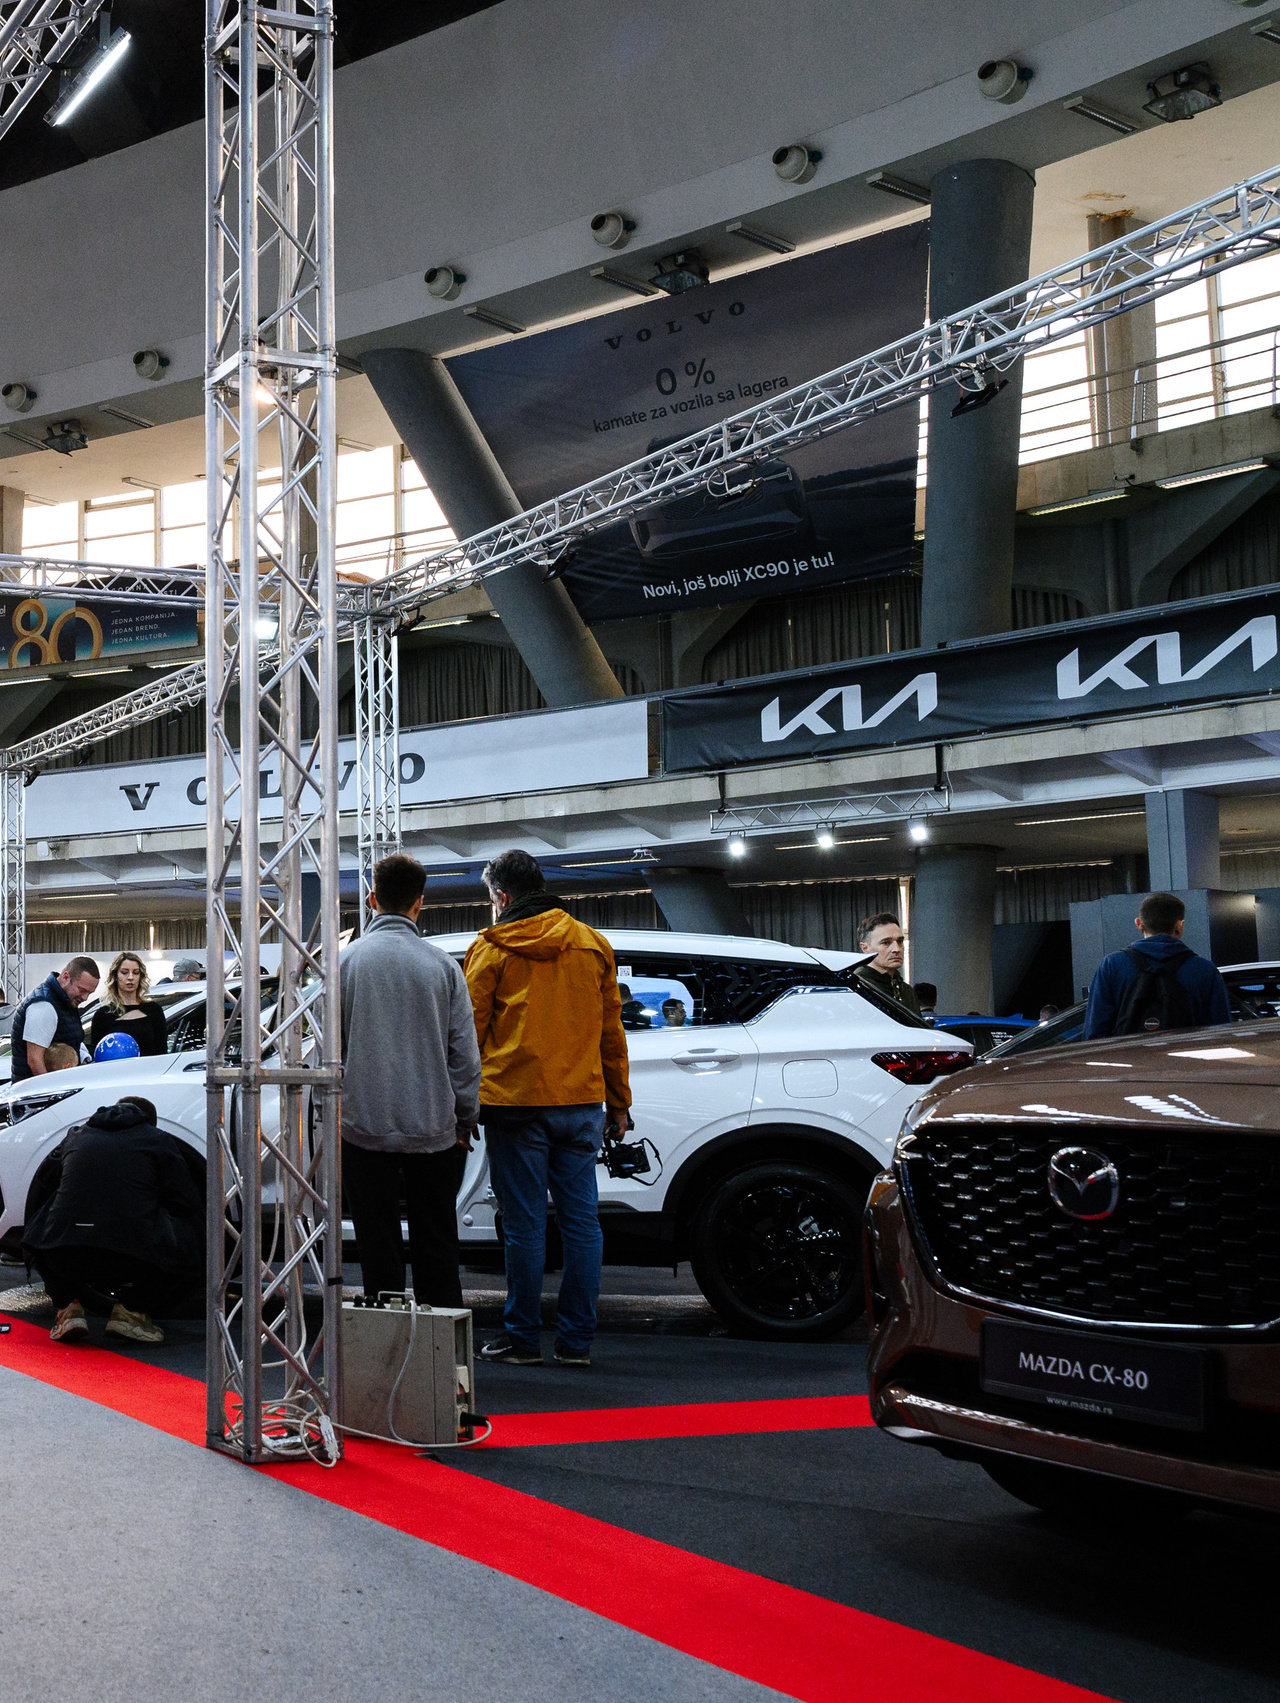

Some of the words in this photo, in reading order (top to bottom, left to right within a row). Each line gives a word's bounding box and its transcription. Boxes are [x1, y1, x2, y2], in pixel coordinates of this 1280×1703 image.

[604, 301, 746, 350] VOLVO
[594, 411, 647, 433] kamate
[650, 405, 668, 421] za
[670, 393, 713, 415] vozila
[717, 388, 735, 405] sa
[737, 374, 789, 402] lagera
[642, 579, 681, 600] Novi,
[683, 571, 707, 593] još
[709, 566, 742, 590] bolji
[744, 560, 789, 583] XC90
[793, 560, 808, 580] je
[811, 552, 836, 572] tu!
[111, 617, 133, 626] JEDNA
[135, 612, 178, 622] KOMPANIJA.
[111, 627, 133, 635] JEDAN
[135, 624, 160, 632] BREND.
[111, 637, 133, 645] JEDNA
[135, 632, 170, 641] KULTURA.
[1056, 615, 1278, 700] KIA
[761, 672, 938, 743] KIA
[1018, 1352, 1085, 1380] MAZDA
[1089, 1363, 1149, 1390] CX-80
[1046, 1396, 1114, 1416] www.mazda.rs
